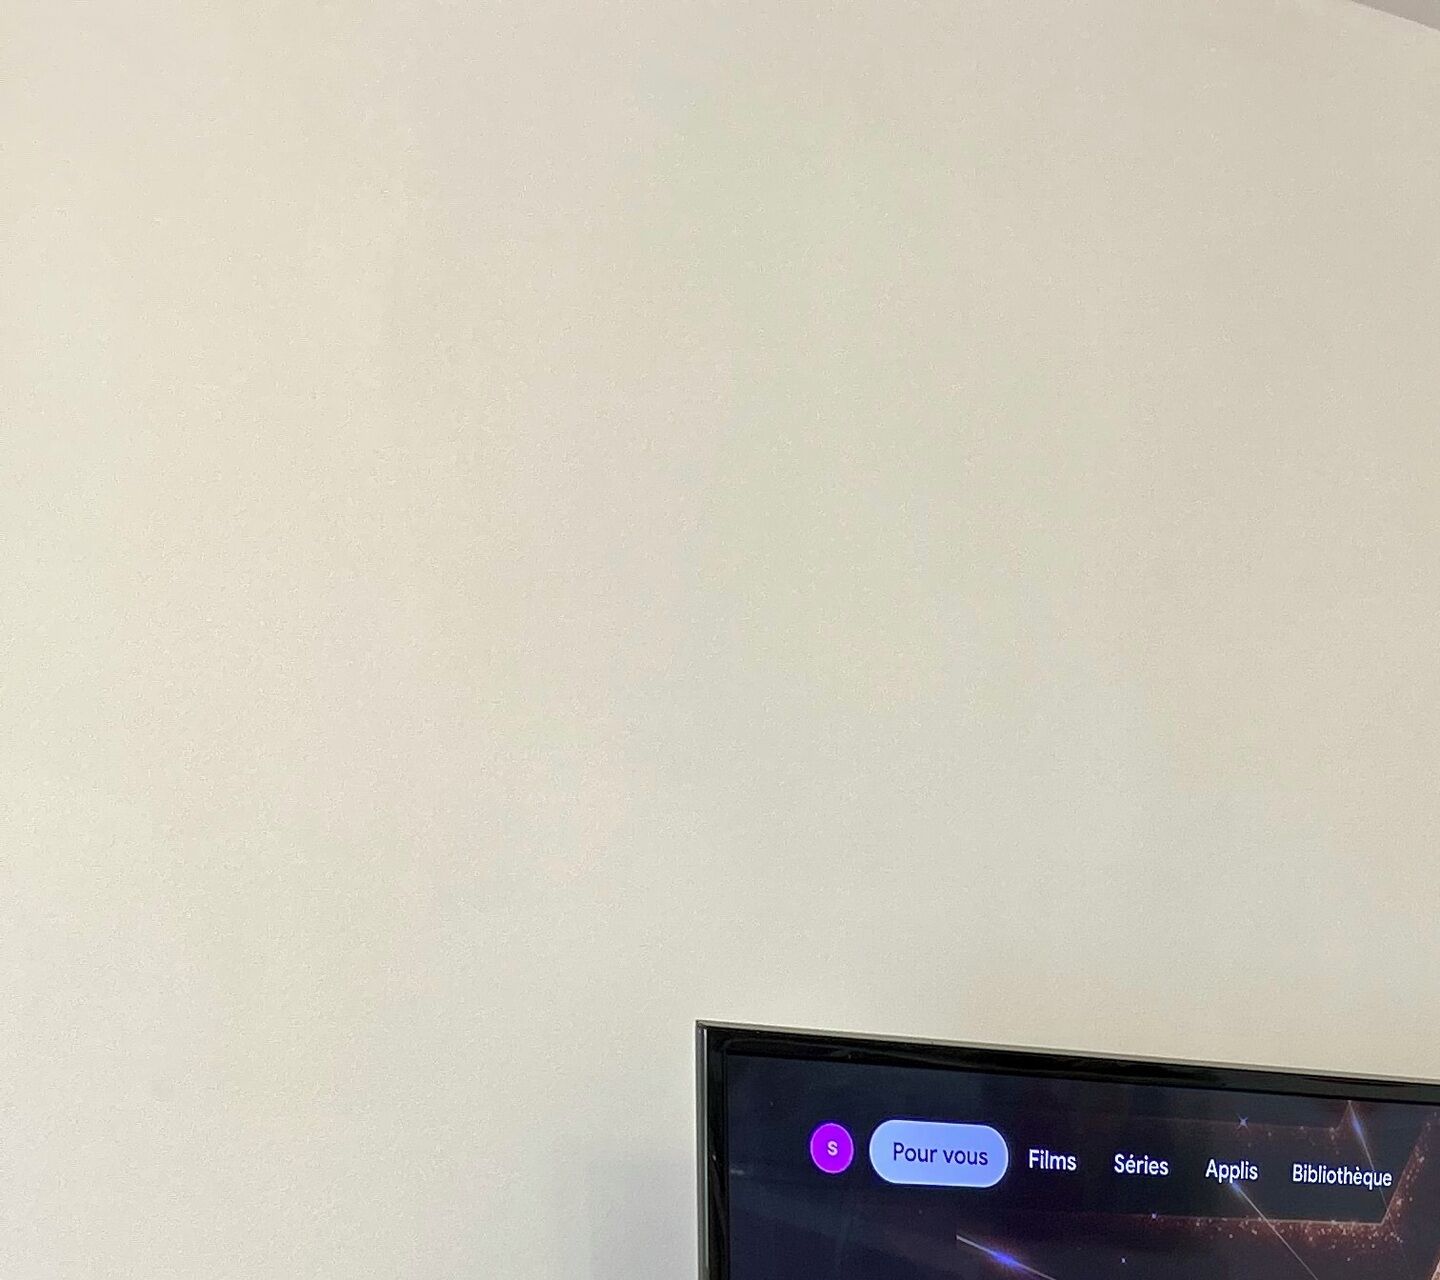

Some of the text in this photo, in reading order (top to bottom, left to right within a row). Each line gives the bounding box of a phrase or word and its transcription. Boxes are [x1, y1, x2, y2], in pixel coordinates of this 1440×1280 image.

[826, 1140, 839, 1157] S
[892, 1142, 989, 1167] Pour vous
[1028, 1149, 1078, 1172] Films
[1113, 1151, 1170, 1177] Séries
[1205, 1158, 1259, 1185] Applis
[1291, 1163, 1393, 1190] Bibliothèque
